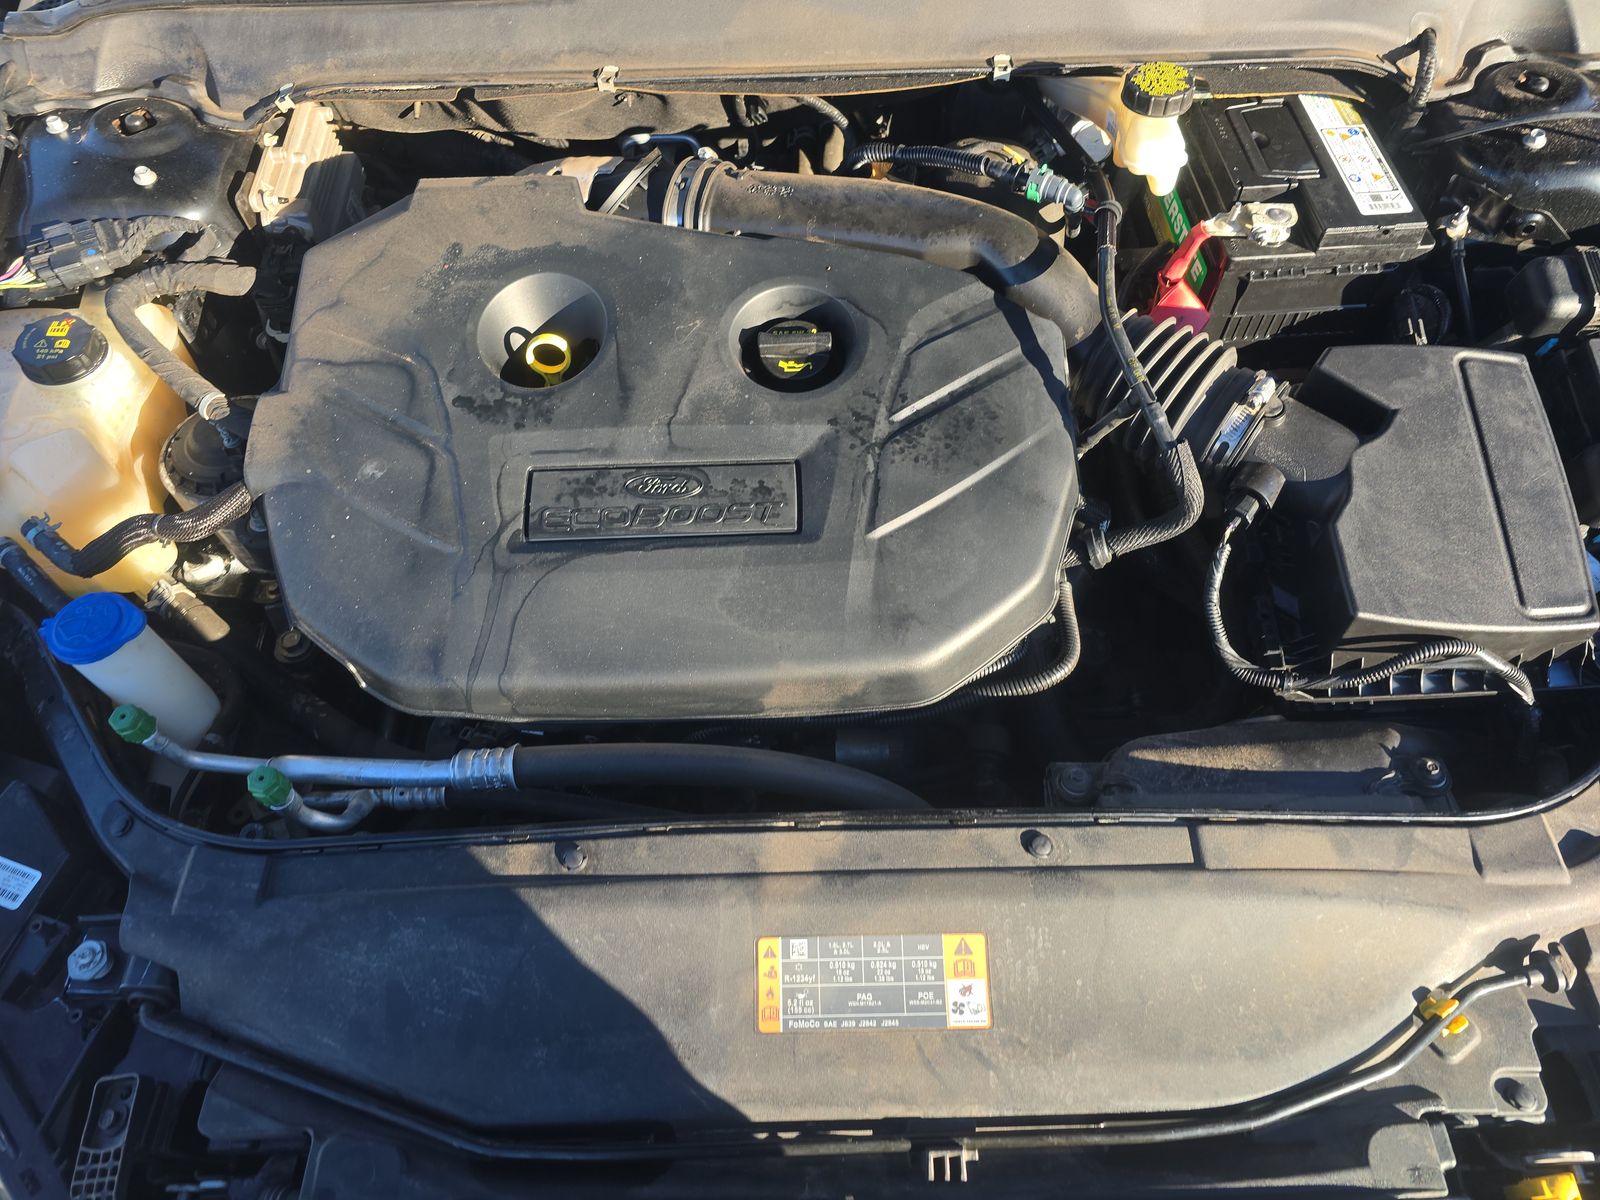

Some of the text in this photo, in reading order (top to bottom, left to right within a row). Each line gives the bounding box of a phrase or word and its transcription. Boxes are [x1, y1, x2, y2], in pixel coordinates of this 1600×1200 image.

[637, 475, 689, 495] Ford
[847, 961, 856, 971] kg
[888, 961, 897, 970] kg
[929, 960, 937, 969] kg
[784, 974, 816, 984] R-1234yf
[917, 991, 934, 1000] POE
[788, 1020, 820, 1029] FoMoCo
[823, 1020, 838, 1028] SAE
